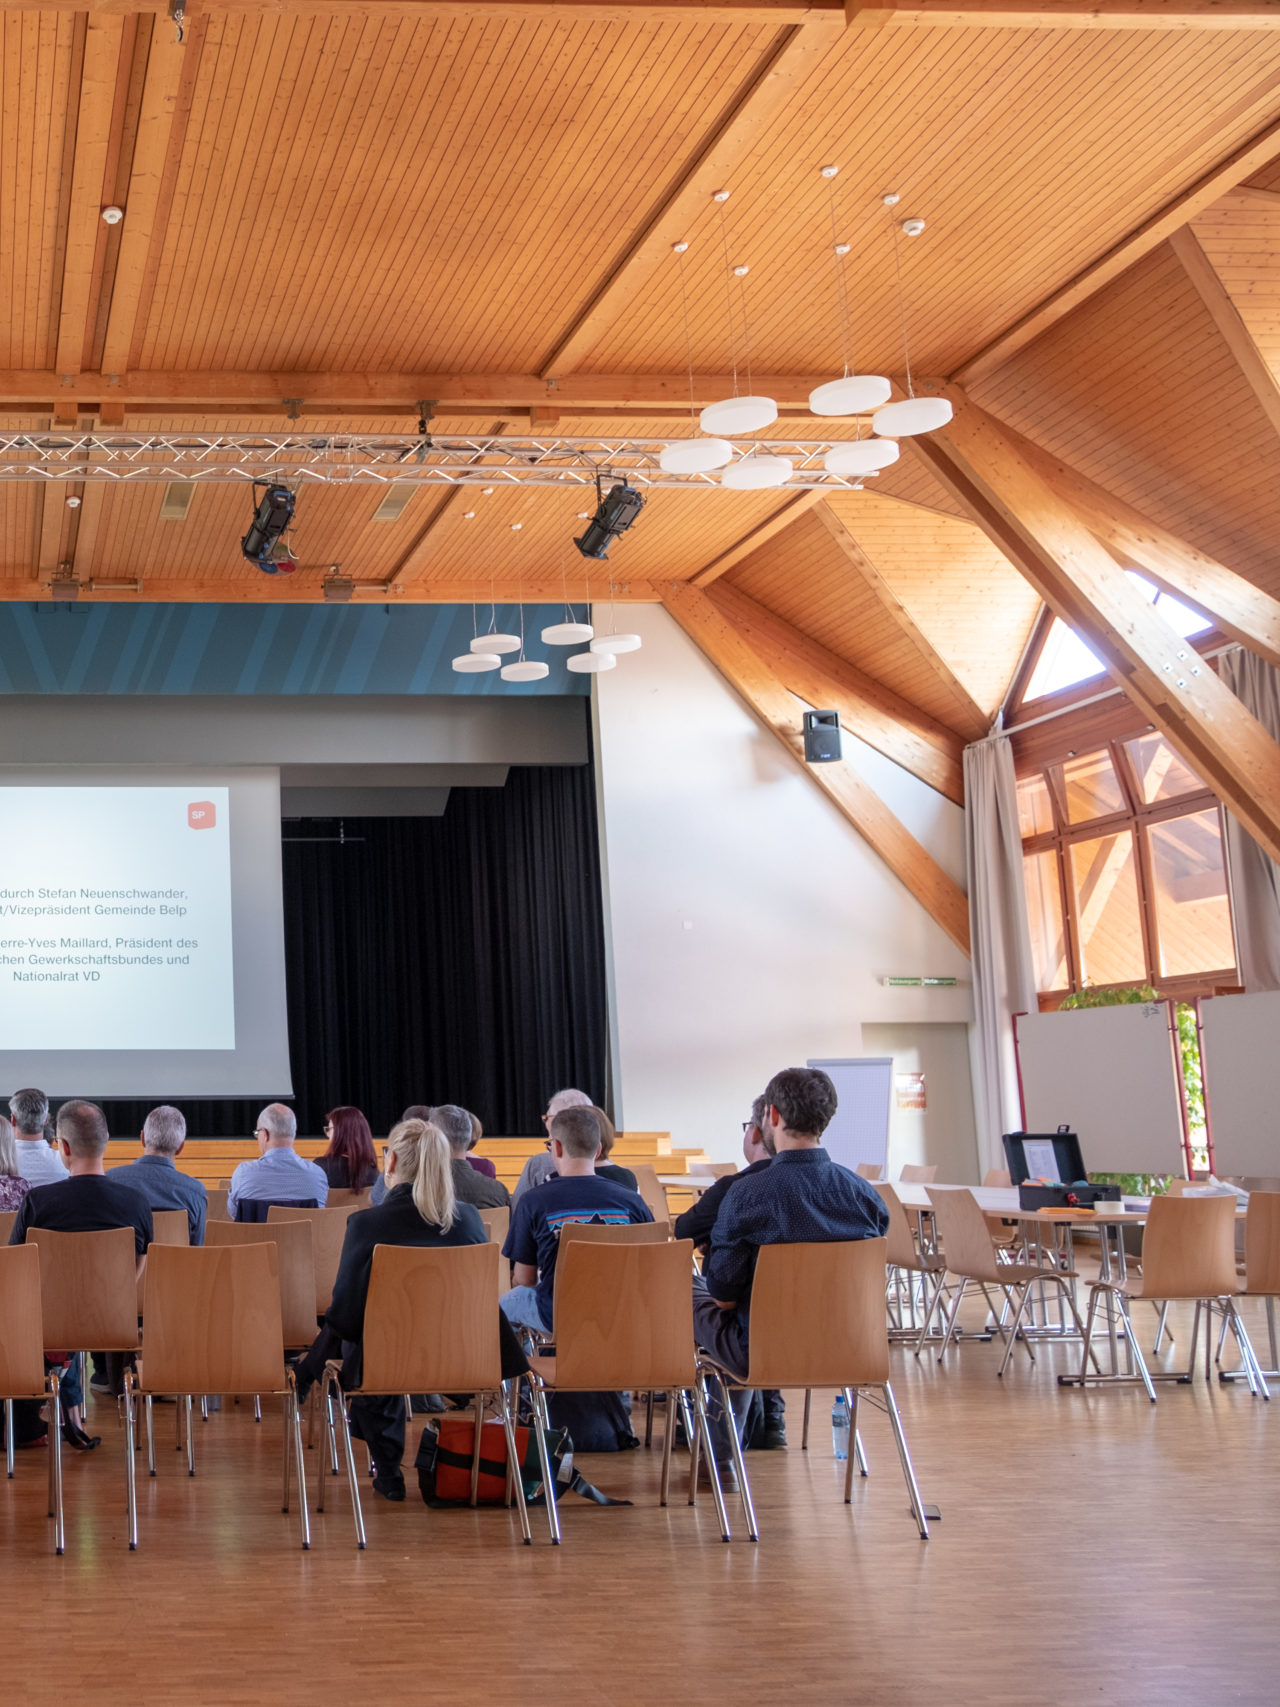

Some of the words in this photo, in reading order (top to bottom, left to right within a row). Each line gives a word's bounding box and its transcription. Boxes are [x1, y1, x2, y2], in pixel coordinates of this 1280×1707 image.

[191, 810, 206, 819] SP
[0, 888, 35, 899] durch
[37, 888, 77, 899] Stefan
[80, 888, 189, 900] Neuenschwander,
[94, 904, 156, 916] Gemeinde
[159, 904, 188, 917] Belp
[60, 937, 112, 949] Maillard,
[115, 937, 173, 949] Präsident
[176, 937, 199, 949] des
[28, 954, 164, 965] Gewerkschaftsbundes
[166, 954, 190, 965] und
[13, 971, 79, 982] Nationalrat
[82, 971, 101, 982] VD
